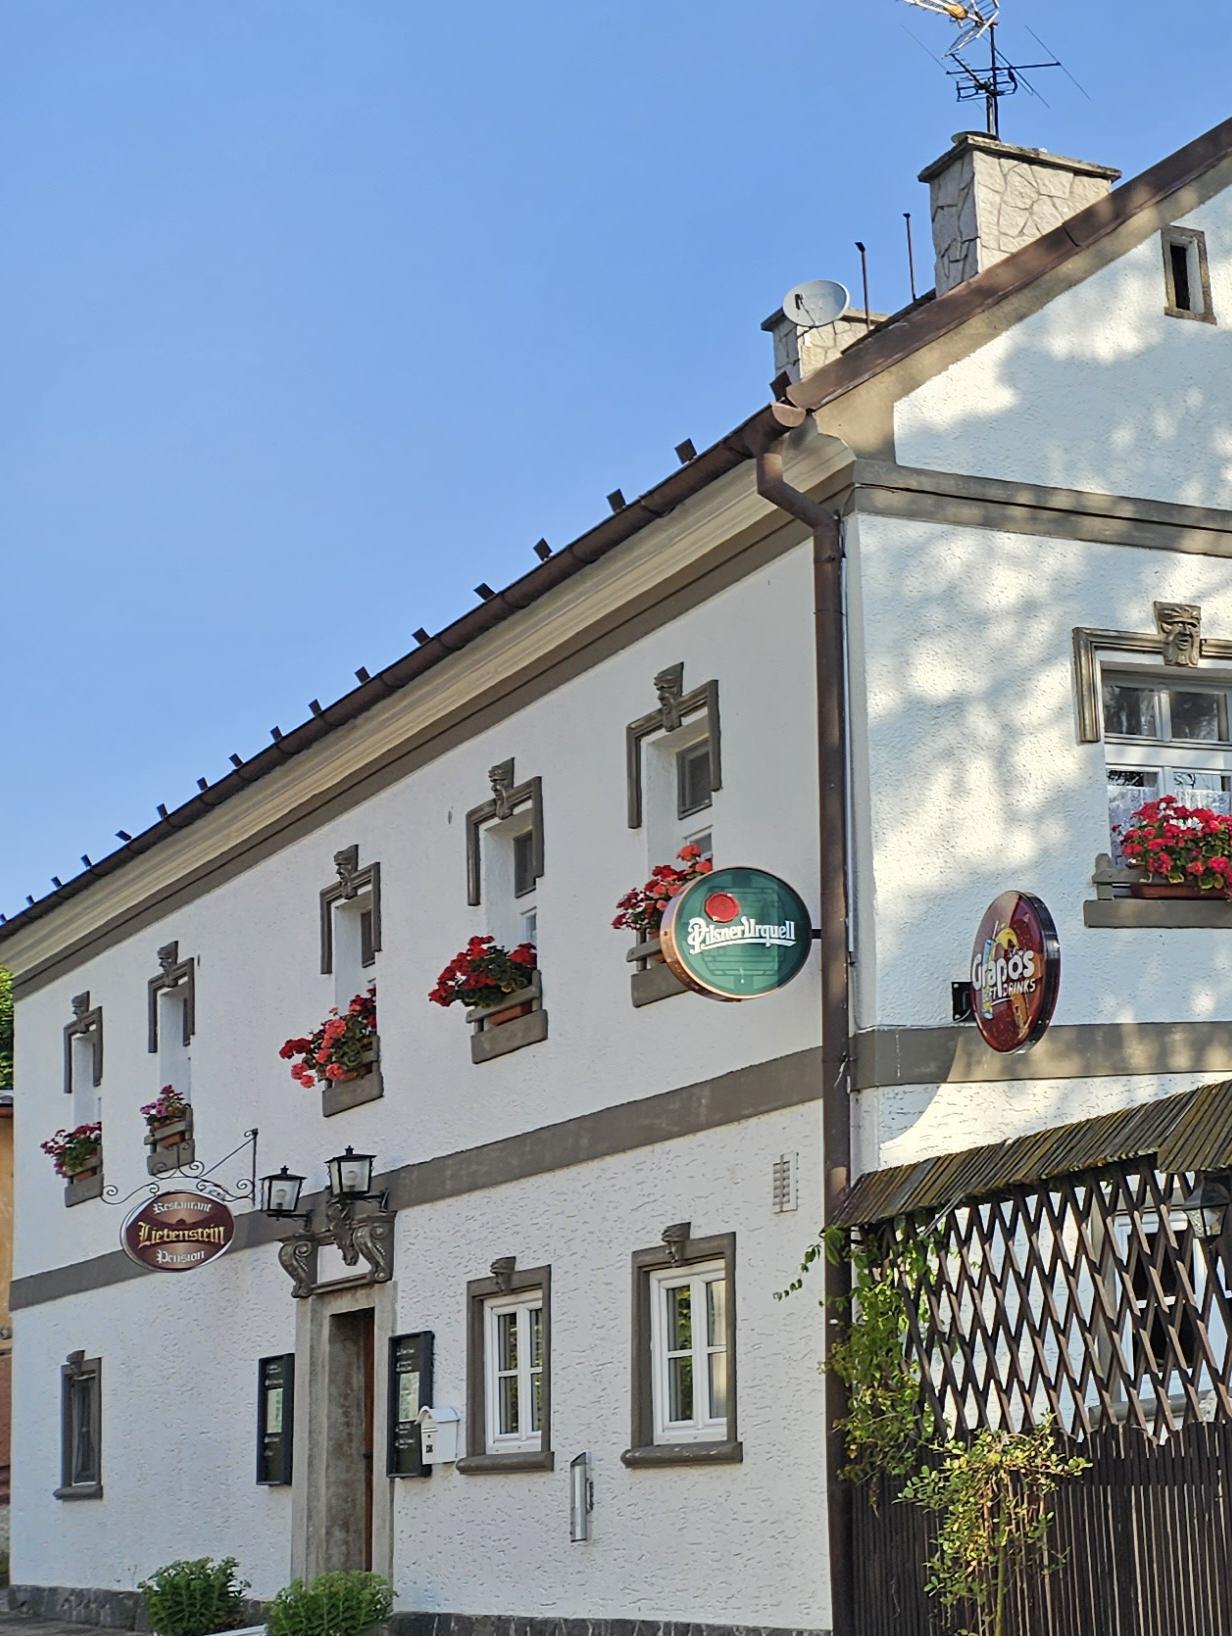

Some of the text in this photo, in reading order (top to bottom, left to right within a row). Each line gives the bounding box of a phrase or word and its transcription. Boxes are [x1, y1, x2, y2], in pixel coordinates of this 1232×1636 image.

[687, 916, 796, 955] Pilsner Urquell
[153, 1200, 212, 1215] Restaurant
[137, 1221, 225, 1249] Liebenstein
[155, 1249, 205, 1264] Pension
